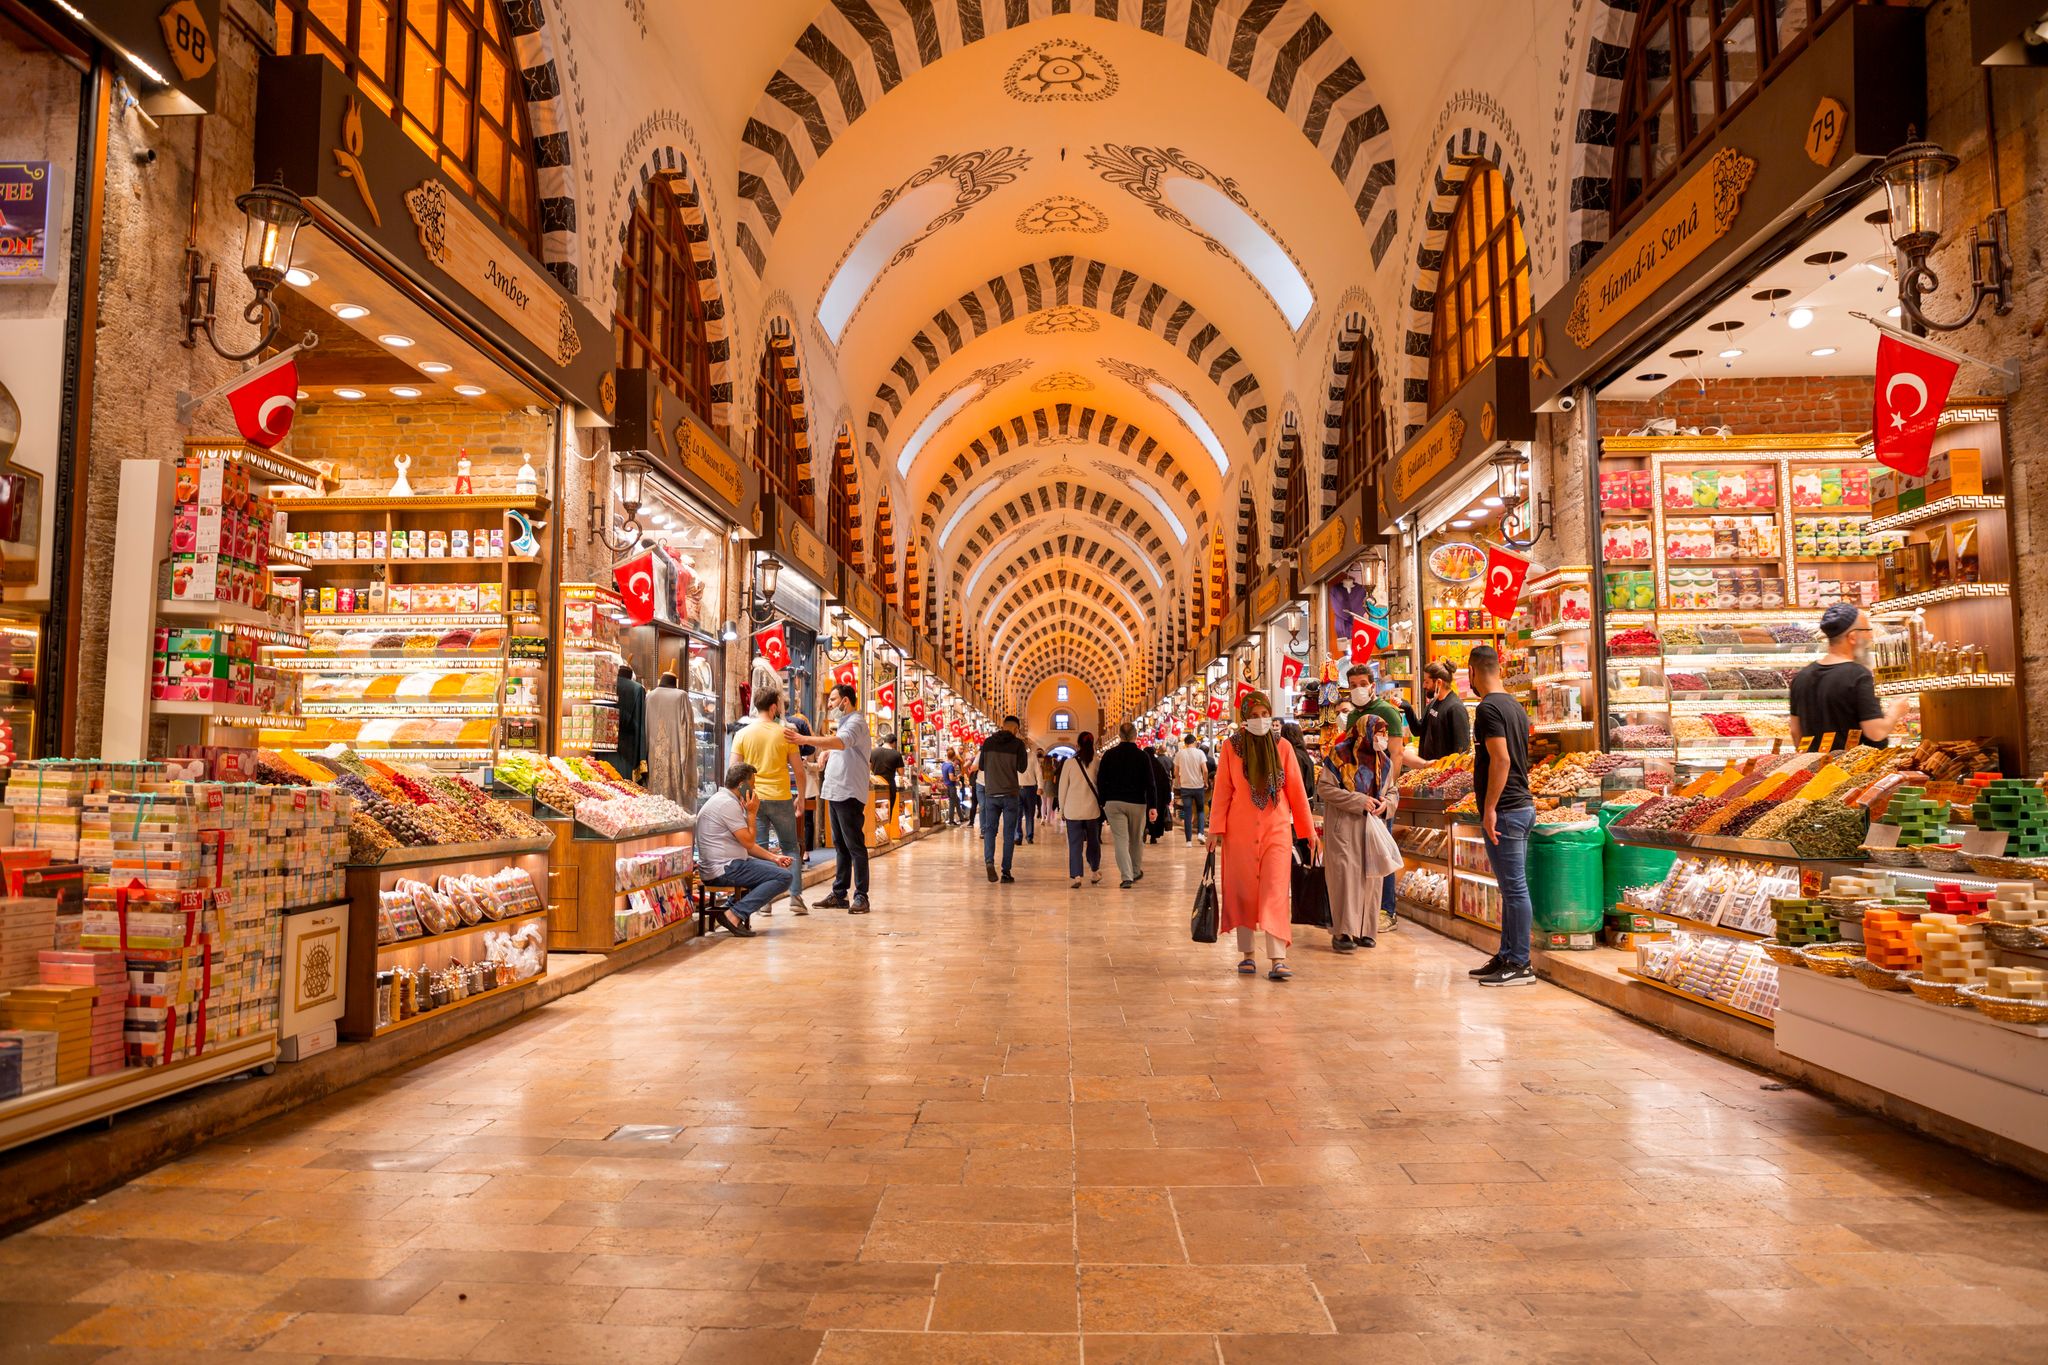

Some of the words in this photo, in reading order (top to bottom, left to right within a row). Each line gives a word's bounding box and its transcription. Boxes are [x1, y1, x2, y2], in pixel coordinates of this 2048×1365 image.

[176, 13, 206, 64] 88
[1813, 109, 1835, 153] 79
[1599, 241, 1657, 312] Hamd-ü
[1660, 201, 1700, 259] Senâ
[484, 259, 530, 311] Amber
[604, 382, 614, 404] 86
